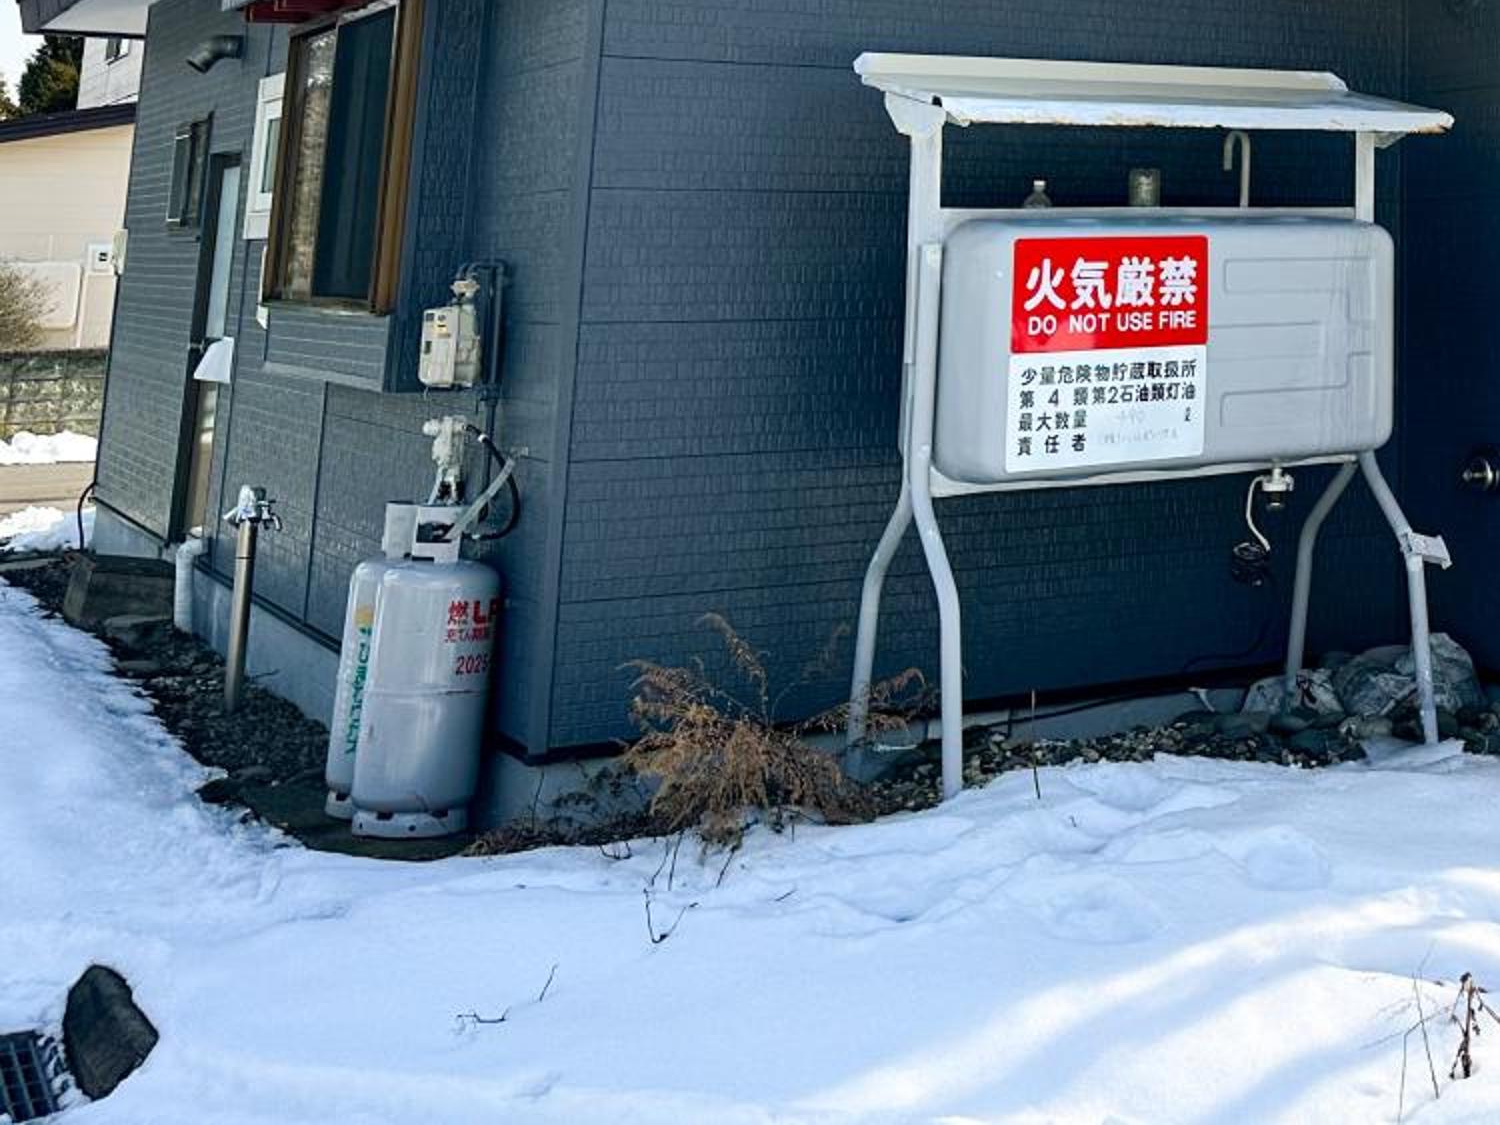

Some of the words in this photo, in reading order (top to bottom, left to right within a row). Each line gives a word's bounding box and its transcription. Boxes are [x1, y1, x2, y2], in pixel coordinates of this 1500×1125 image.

[1023, 255, 1198, 311] 火気厳禁
[1027, 315, 1057, 336] DO
[1068, 313, 1111, 333] NOT
[1116, 312, 1153, 332] USE
[1158, 310, 1197, 330] FIRE
[1020, 359, 1198, 386] 少量危険物貯蔵取扱所
[1017, 410, 1088, 432] 最大数量
